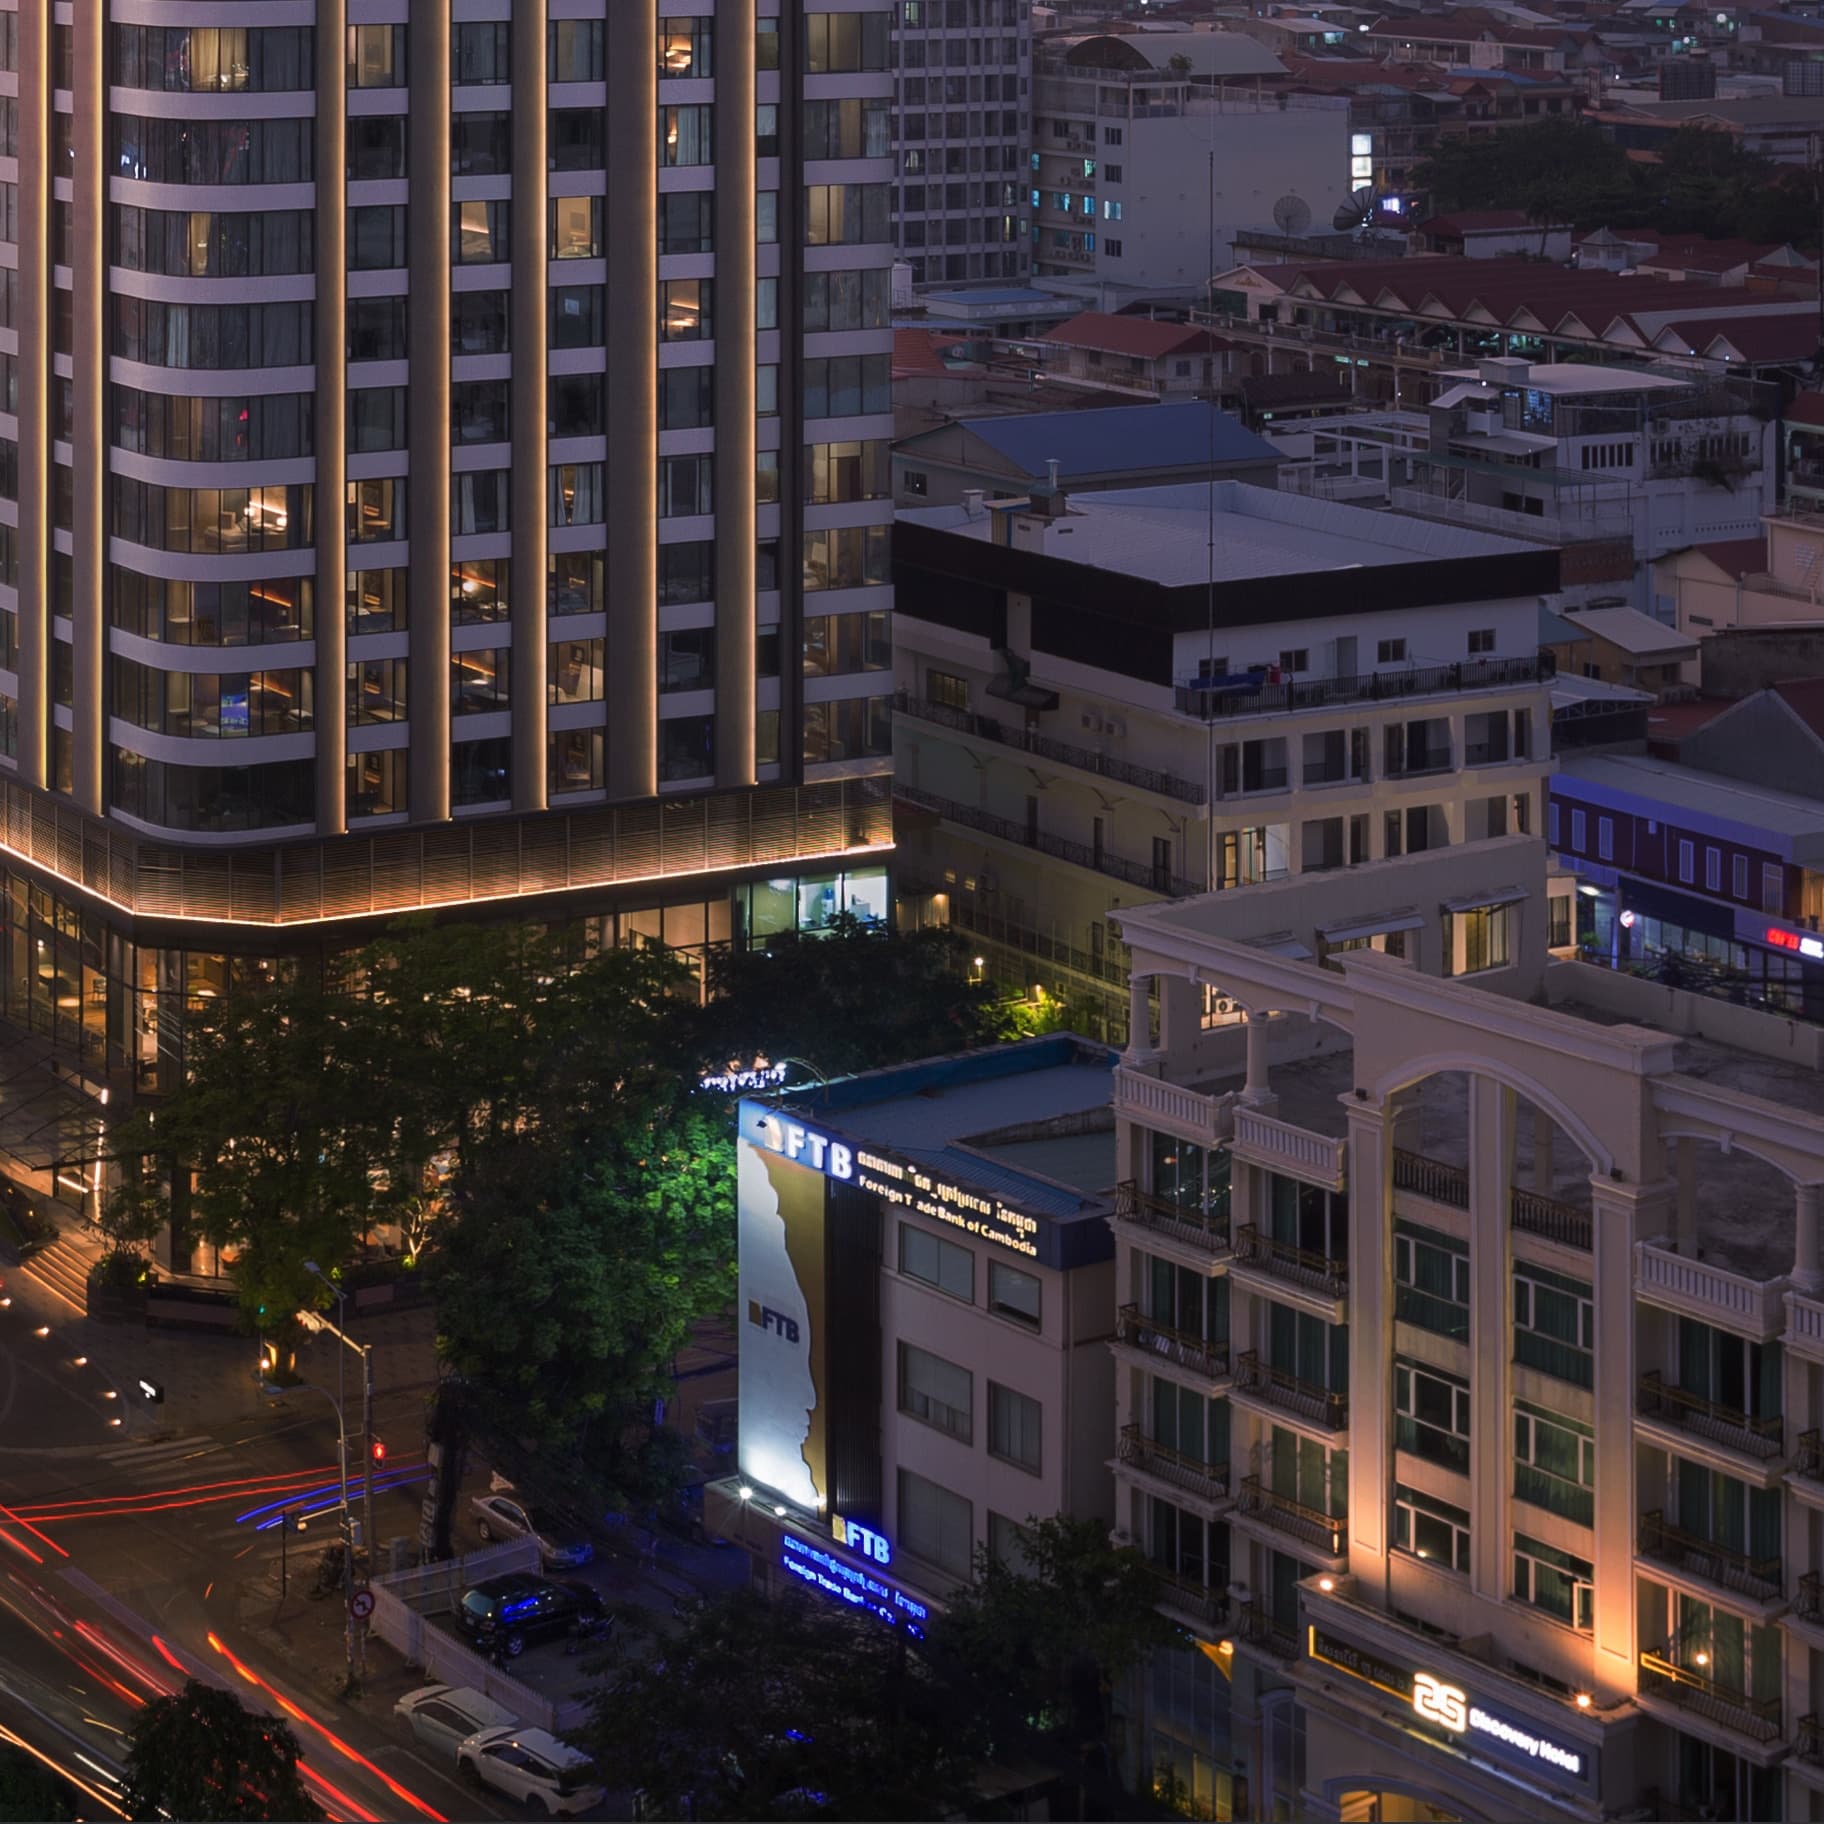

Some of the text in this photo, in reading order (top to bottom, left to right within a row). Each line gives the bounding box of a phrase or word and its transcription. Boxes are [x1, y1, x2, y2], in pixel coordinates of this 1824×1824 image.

[785, 1125, 852, 1179] FTB
[859, 1175, 1038, 1257] Foreign Tade Bank of Cambodia
[762, 1305, 800, 1344] FTB
[847, 1520, 891, 1564] FTB
[1469, 1707, 1581, 1773] Discovery Hotel
